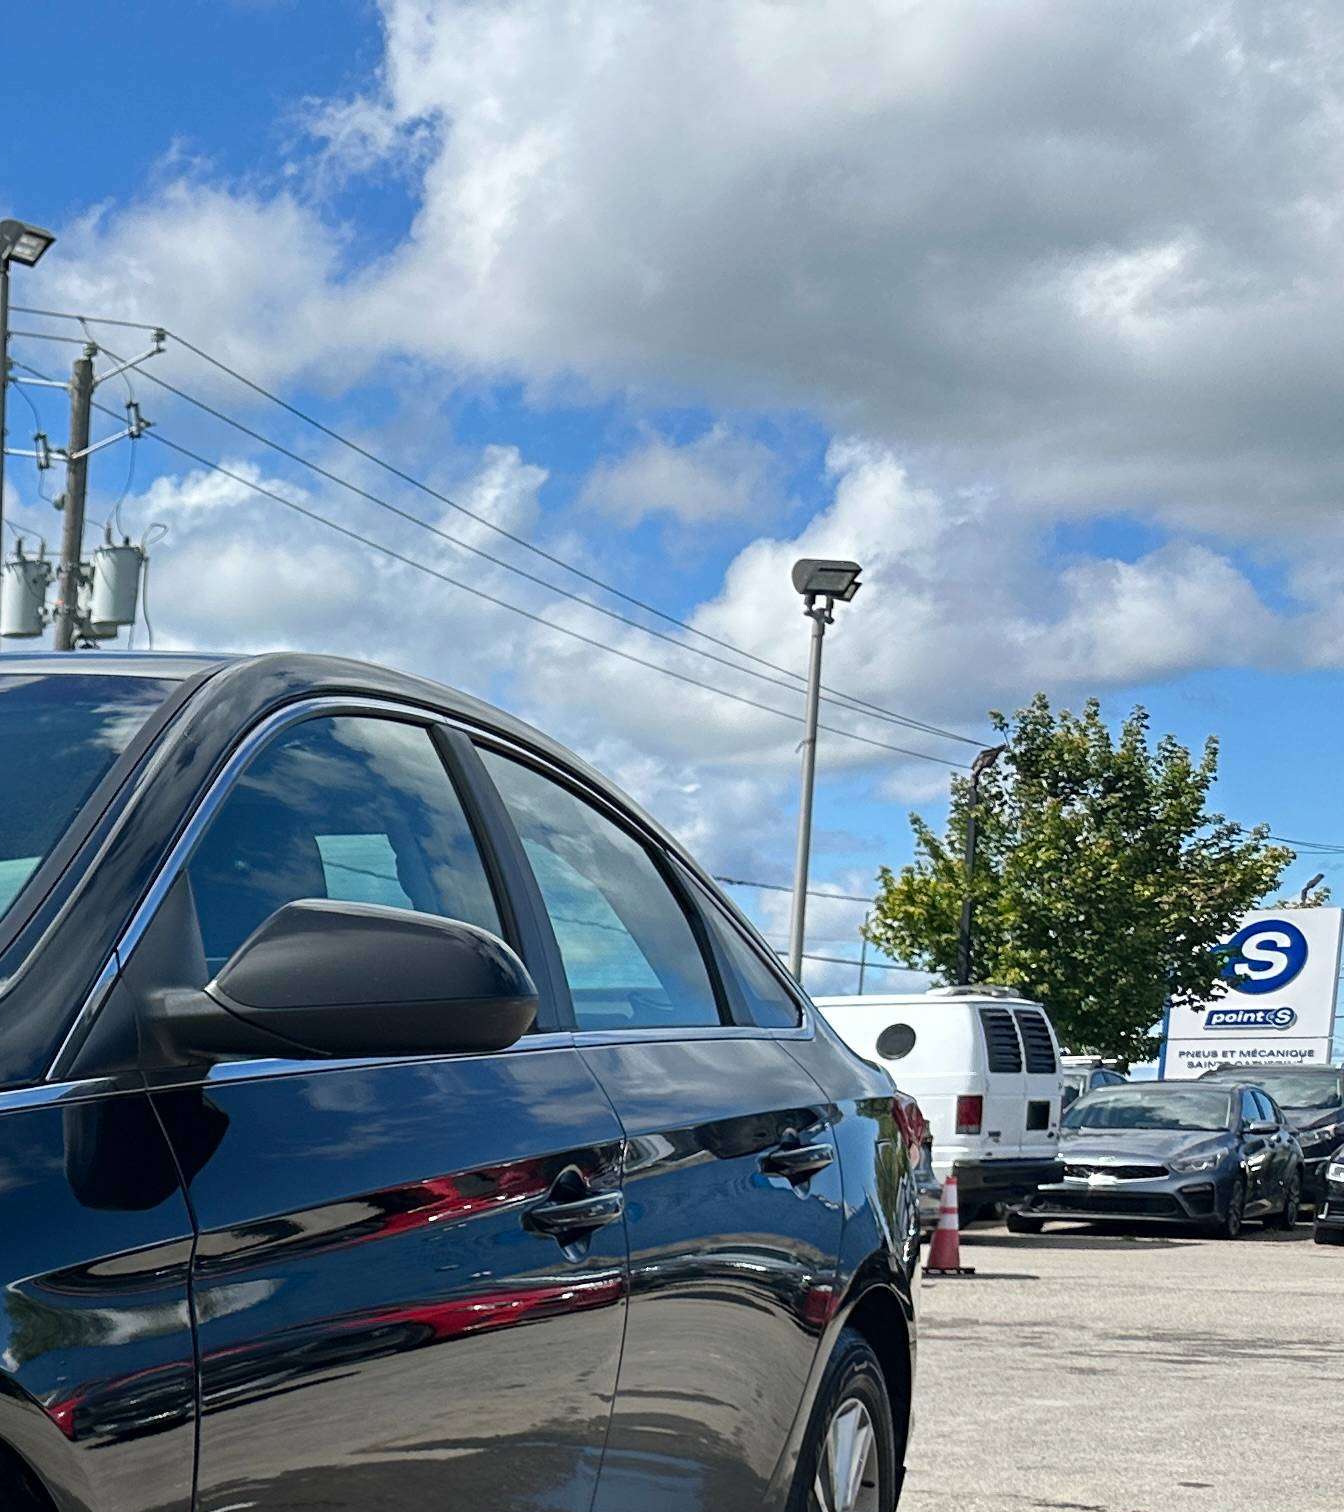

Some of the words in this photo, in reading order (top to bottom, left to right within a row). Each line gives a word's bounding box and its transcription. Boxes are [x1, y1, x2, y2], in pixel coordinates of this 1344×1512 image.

[1234, 931, 1292, 980] S
[1211, 1011, 1264, 1025] point
[1274, 1008, 1292, 1024] S
[1178, 1050, 1218, 1058] PNEUS
[1221, 1050, 1236, 1058] ET
[1238, 1048, 1315, 1058] MÉCANIQUE
